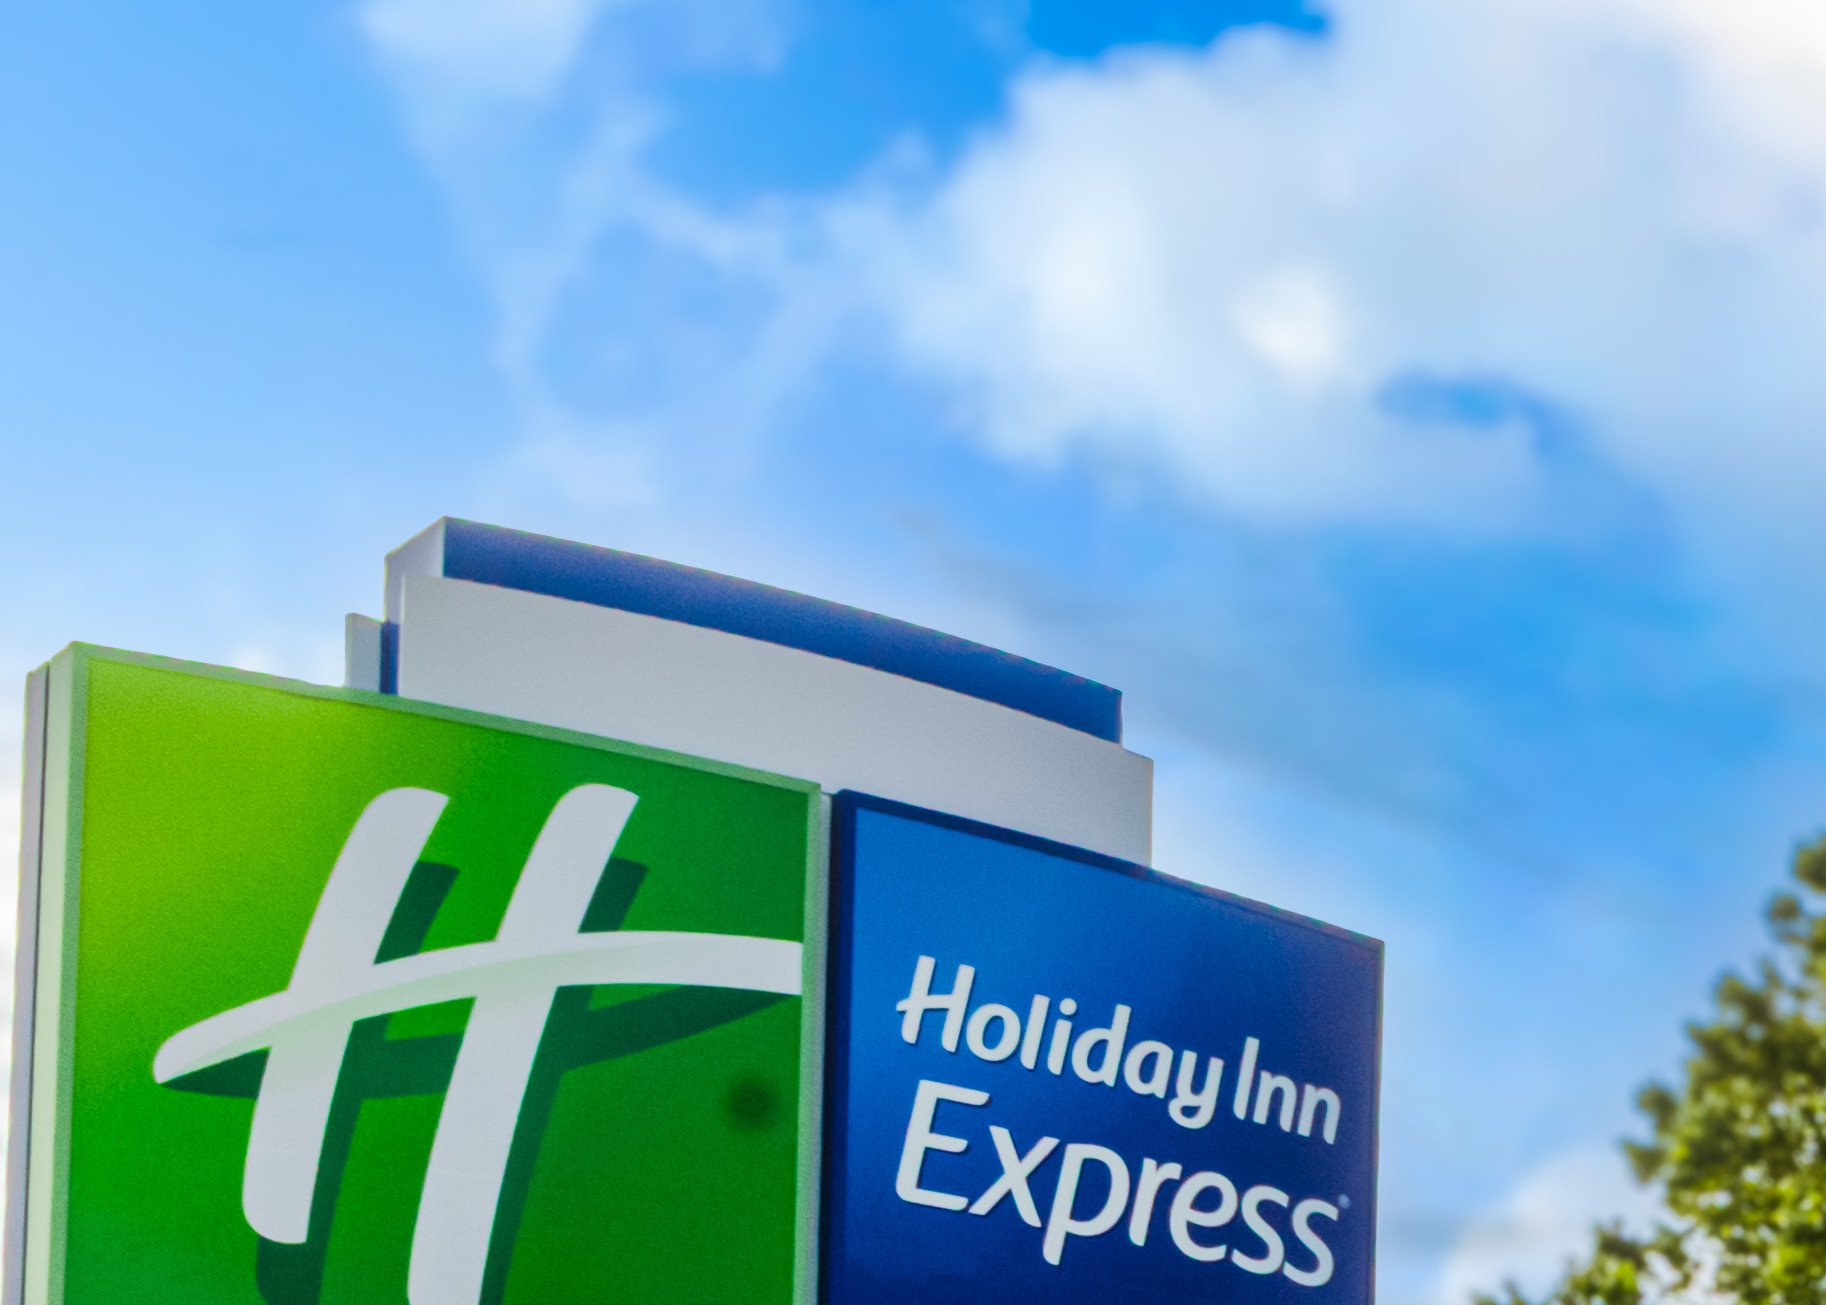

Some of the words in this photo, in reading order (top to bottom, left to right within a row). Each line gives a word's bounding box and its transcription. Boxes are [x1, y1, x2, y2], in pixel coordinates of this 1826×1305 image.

[896, 955, 1224, 1129] Holiday
[1233, 1036, 1341, 1145] Inn
[895, 1079, 1341, 1287] Express
